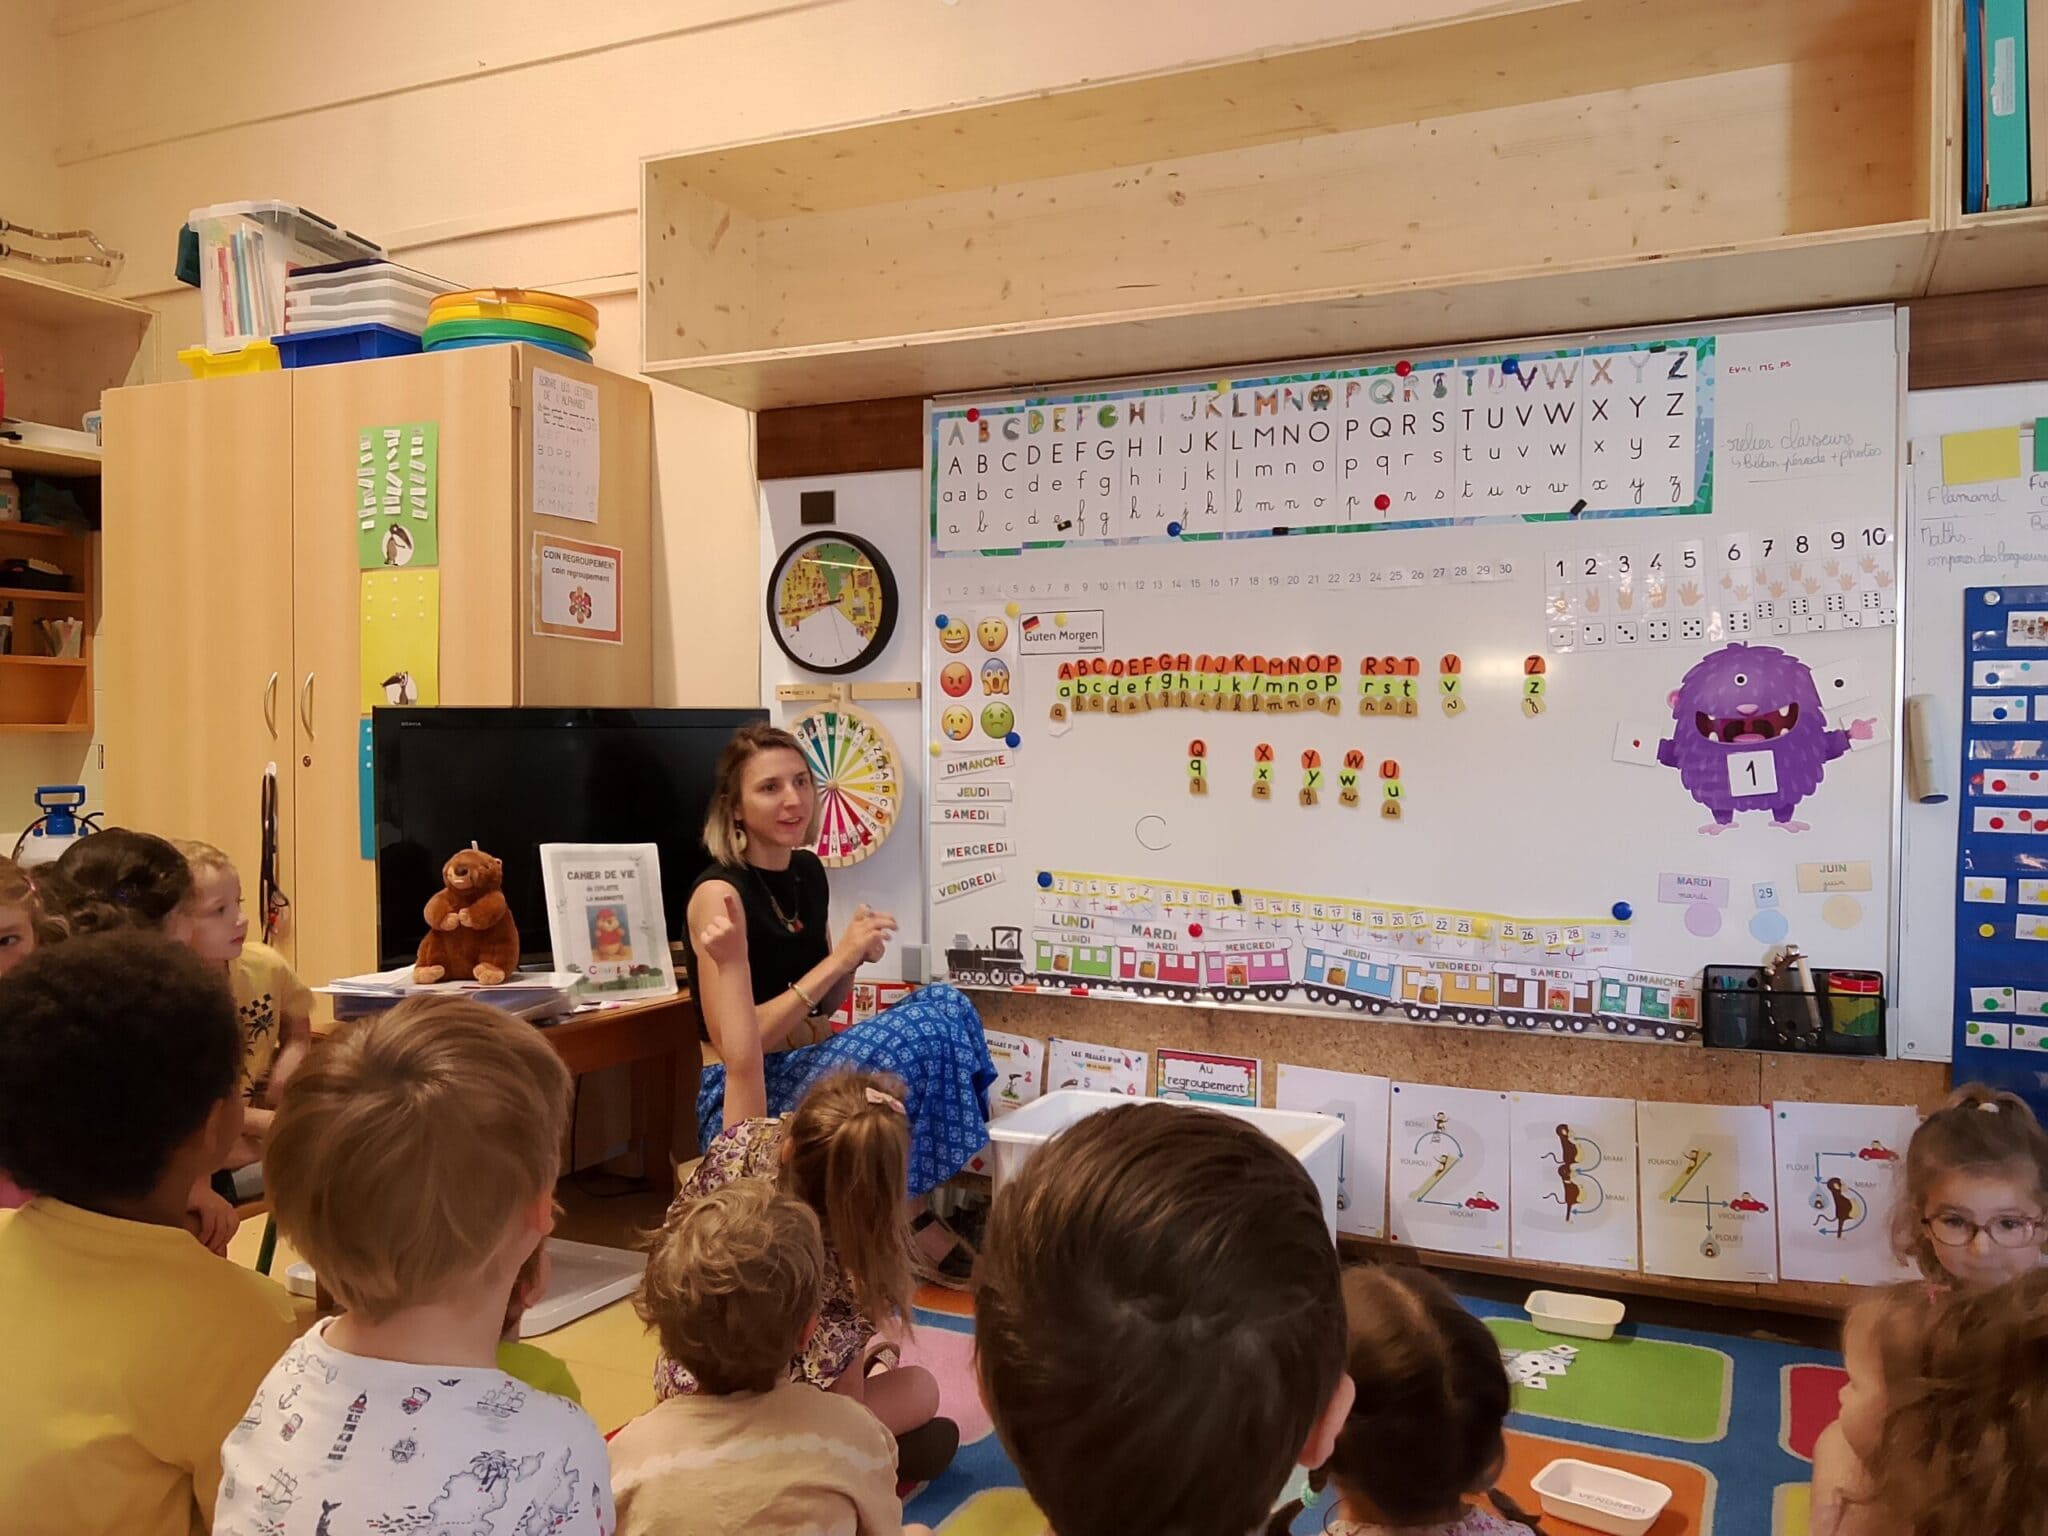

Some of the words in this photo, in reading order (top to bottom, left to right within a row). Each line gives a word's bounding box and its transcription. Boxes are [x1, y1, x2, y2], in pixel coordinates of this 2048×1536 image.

[949, 456, 962, 475] A
[978, 455, 987, 473] B
[1002, 453, 1017, 471] C
[1028, 446, 1040, 464] D
[1052, 444, 1063, 463] E
[1077, 442, 1087, 461] F
[1097, 441, 1114, 460] G
[1129, 438, 1141, 457] H
[1159, 436, 1162, 455] I
[1180, 433, 1192, 453] J
[1205, 431, 1218, 451] K
[1233, 430, 1242, 449] L
[1255, 427, 1274, 447] M
[1283, 424, 1299, 445] N
[1309, 422, 1329, 442] O
[1347, 420, 1359, 440] P
[1370, 417, 1391, 437] Q
[1403, 414, 1415, 435] R
[1432, 412, 1445, 432] S
[1462, 409, 1474, 430] T
[1488, 407, 1503, 428] U
[1516, 405, 1532, 426] V
[1544, 402, 1575, 424] W
[1592, 399, 1608, 421] X
[1629, 396, 1646, 418] Y
[1667, 393, 1684, 416] Z
[978, 483, 987, 500] b
[1005, 489, 1013, 499] c
[1028, 474, 1039, 492] d
[1052, 480, 1062, 490] e
[1078, 471, 1087, 489] f
[1100, 477, 1110, 496] g
[1131, 467, 1139, 485] h
[1158, 468, 1161, 483] i
[1182, 467, 1187, 490] j
[1207, 462, 1215, 480] k
[1256, 464, 1272, 477] m
[1286, 463, 1295, 474] n
[1313, 460, 1324, 471] o
[1346, 459, 1357, 479] p
[1377, 456, 1388, 475] q
[1404, 454, 1414, 465] r
[1434, 451, 1442, 463] s
[1463, 445, 1472, 461] t
[1490, 448, 1500, 459] u
[1518, 446, 1528, 457] v
[1550, 444, 1566, 455] w
[1594, 441, 1604, 453] x
[1631, 438, 1642, 459] y
[1669, 435, 1680, 448] z
[544, 550, 561, 560] COIN
[1556, 561, 1564, 577] 1
[1585, 558, 1596, 575] 2
[1619, 556, 1630, 573] 3
[1650, 553, 1662, 570] 4
[1684, 551, 1696, 568] 5
[1728, 544, 1740, 561] 6
[1762, 540, 1774, 557] 7
[1797, 536, 1809, 553] 8
[1831, 532, 1845, 549] 9
[1862, 528, 1887, 546] 10
[1433, 568, 1445, 578] 27
[1455, 567, 1467, 576] 28
[1477, 566, 1490, 575] 29
[1499, 564, 1512, 574] 30
[1025, 632, 1055, 642] Guten
[1059, 630, 1098, 642] Morgen
[1528, 657, 1540, 674] Z
[947, 756, 1005, 773] DIMANCHE
[1746, 760, 1756, 786] 1
[957, 787, 990, 797] JEUDI
[945, 809, 989, 820] SAMEDI
[947, 843, 1007, 858] MERCREDI
[567, 870, 600, 880] CAHIER
[604, 871, 616, 879] DE
[621, 870, 635, 878] VIE
[1819, 864, 1847, 873] JUIN
[939, 872, 996, 896] VENDREDI
[1677, 877, 1712, 888] MARDI
[1758, 888, 1773, 899] 29
[1052, 914, 1094, 929] LUNDI
[1132, 924, 1177, 940] MARDI
[1292, 904, 1300, 913] 15
[1313, 907, 1322, 916] 16
[1352, 912, 1361, 921] 18
[1373, 915, 1383, 924] 19
[1436, 921, 1447, 930] 22
[1458, 923, 1469, 932] 23
[1504, 925, 1514, 935] 25
[1523, 931, 1533, 940] 26
[1547, 934, 1558, 944] 27
[1567, 928, 1578, 939] 28
[1062, 934, 1090, 944] LUNDI
[1147, 942, 1178, 951] MARDI
[1226, 942, 1274, 951] MERCREDI
[1429, 962, 1481, 972] VENDREDI
[1531, 968, 1573, 979] SAMEDI
[1627, 973, 1686, 988] DIMANCHE
[1199, 1064, 1213, 1074] Au
[1025, 1072, 1032, 1082] 2
[1084, 1078, 1090, 1088] 5
[1127, 1083, 1136, 1095] 6
[1168, 1077, 1245, 1093] regroupement
